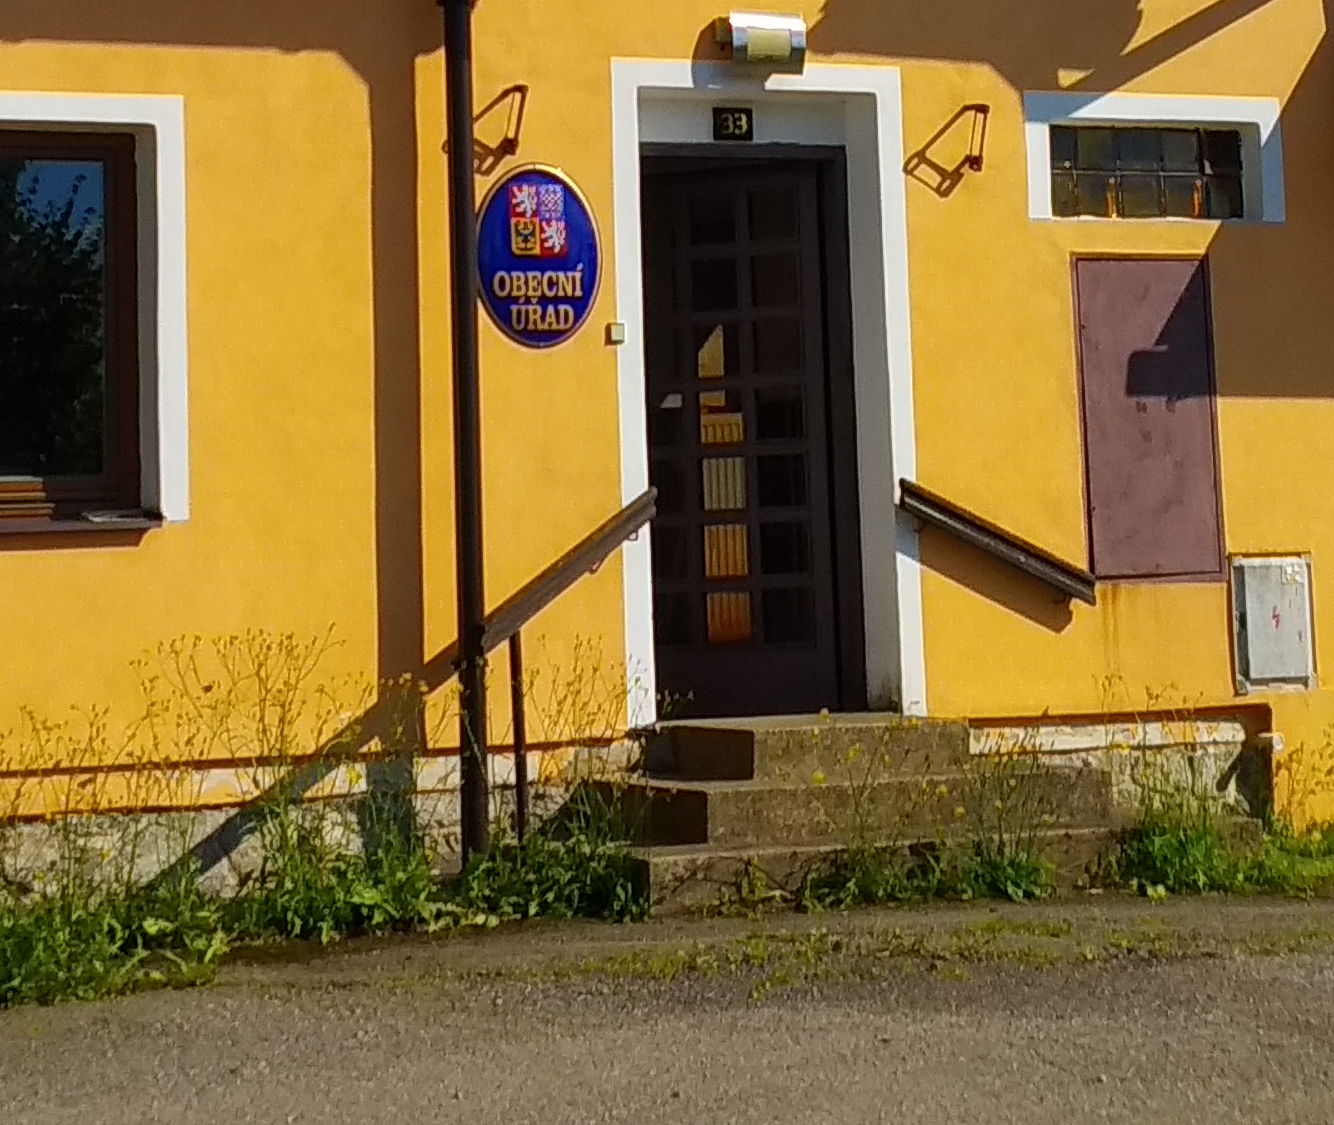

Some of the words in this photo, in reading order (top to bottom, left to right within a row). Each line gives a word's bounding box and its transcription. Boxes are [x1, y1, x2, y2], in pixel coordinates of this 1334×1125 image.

[720, 112, 748, 135] 33
[492, 262, 584, 298] OBECNÍ
[510, 296, 574, 331] ÚŘAD
